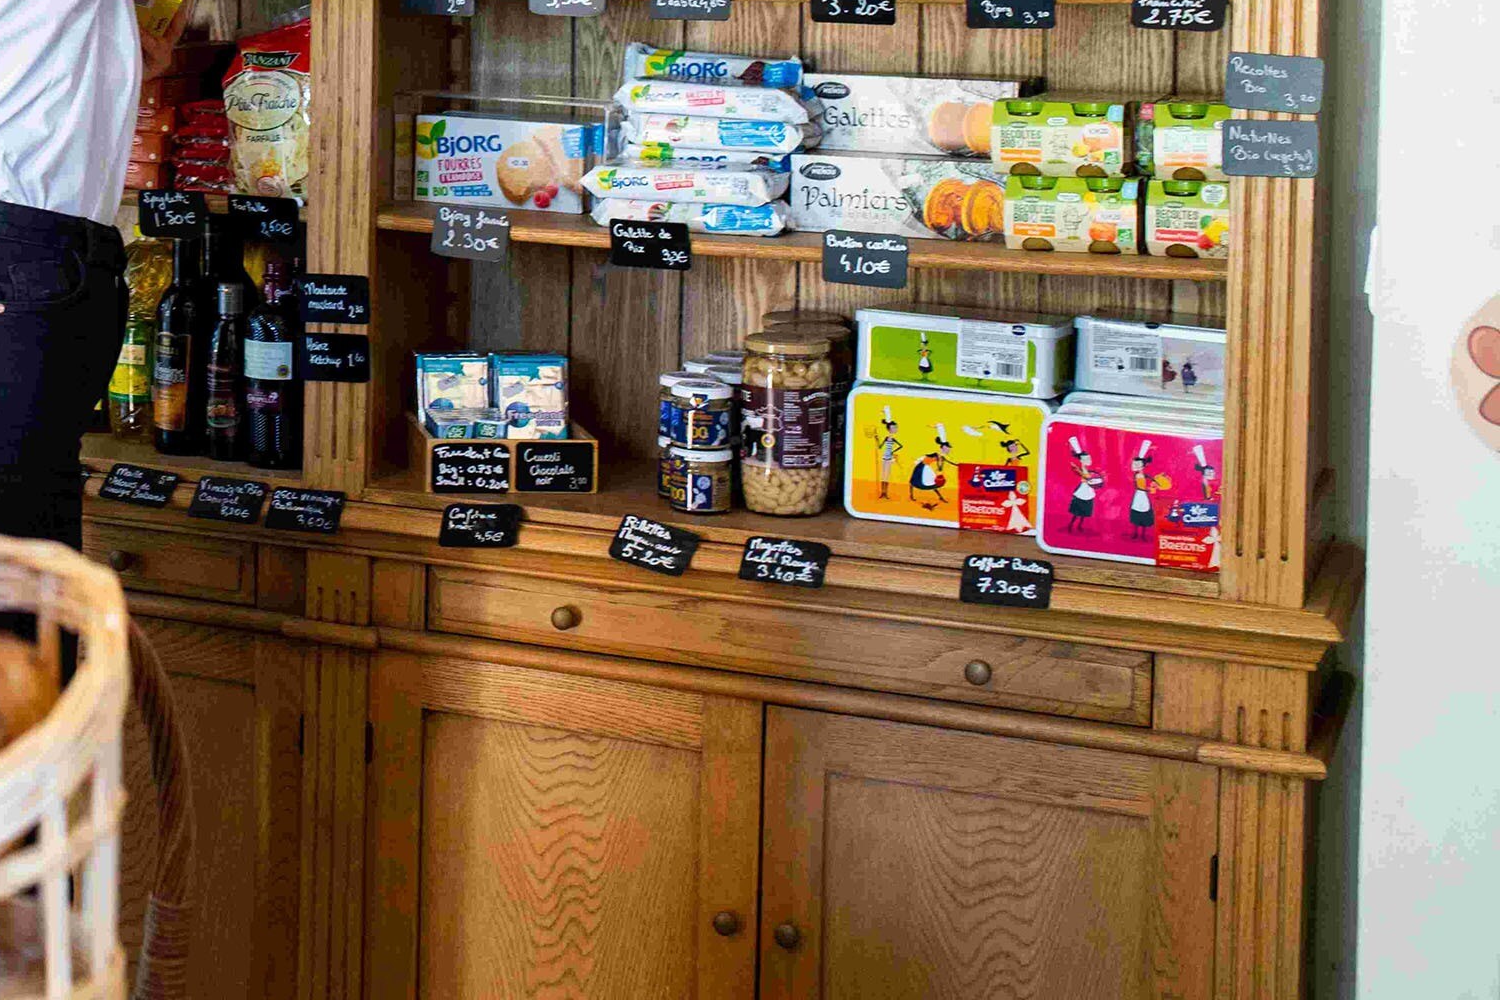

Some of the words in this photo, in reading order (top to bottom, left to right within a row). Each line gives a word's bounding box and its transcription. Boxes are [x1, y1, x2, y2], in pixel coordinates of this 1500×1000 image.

[436, 134, 502, 157] BjORG
[1230, 144, 1261, 161] Bio
[800, 185, 909, 212] Palmiers
[154, 209, 197, 228] 1.50€
[442, 230, 500, 251] 2.30€
[1158, 538, 1207, 553] Bretons
